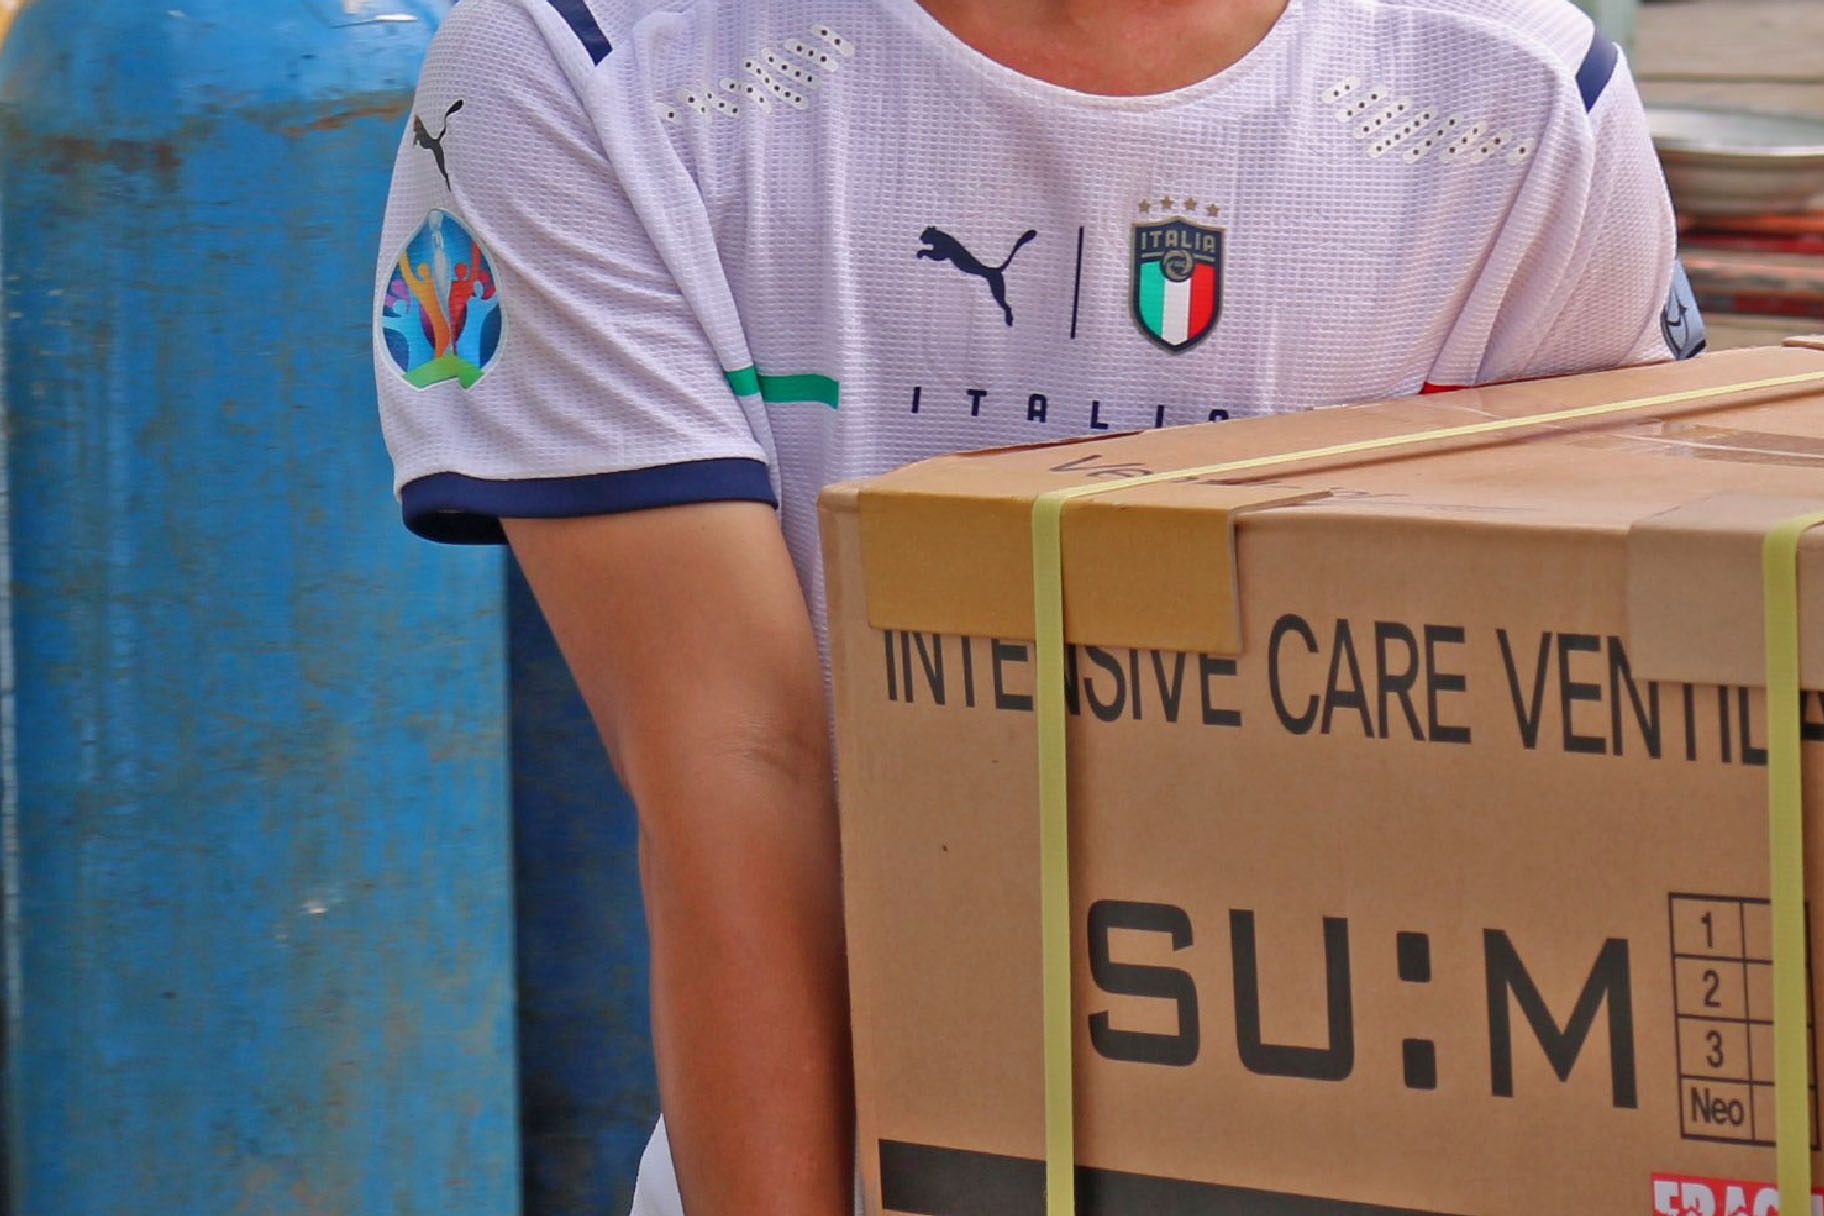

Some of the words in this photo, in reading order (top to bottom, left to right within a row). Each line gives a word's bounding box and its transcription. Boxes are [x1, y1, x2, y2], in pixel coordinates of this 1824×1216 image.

[1141, 229, 1217, 253] ITALIA
[1268, 613, 1472, 745] CARE
[1701, 912, 1713, 948] 1
[1702, 970, 1722, 1008] 2
[1706, 1030, 1724, 1068] 3
[1691, 1087, 1745, 1126] Neo
